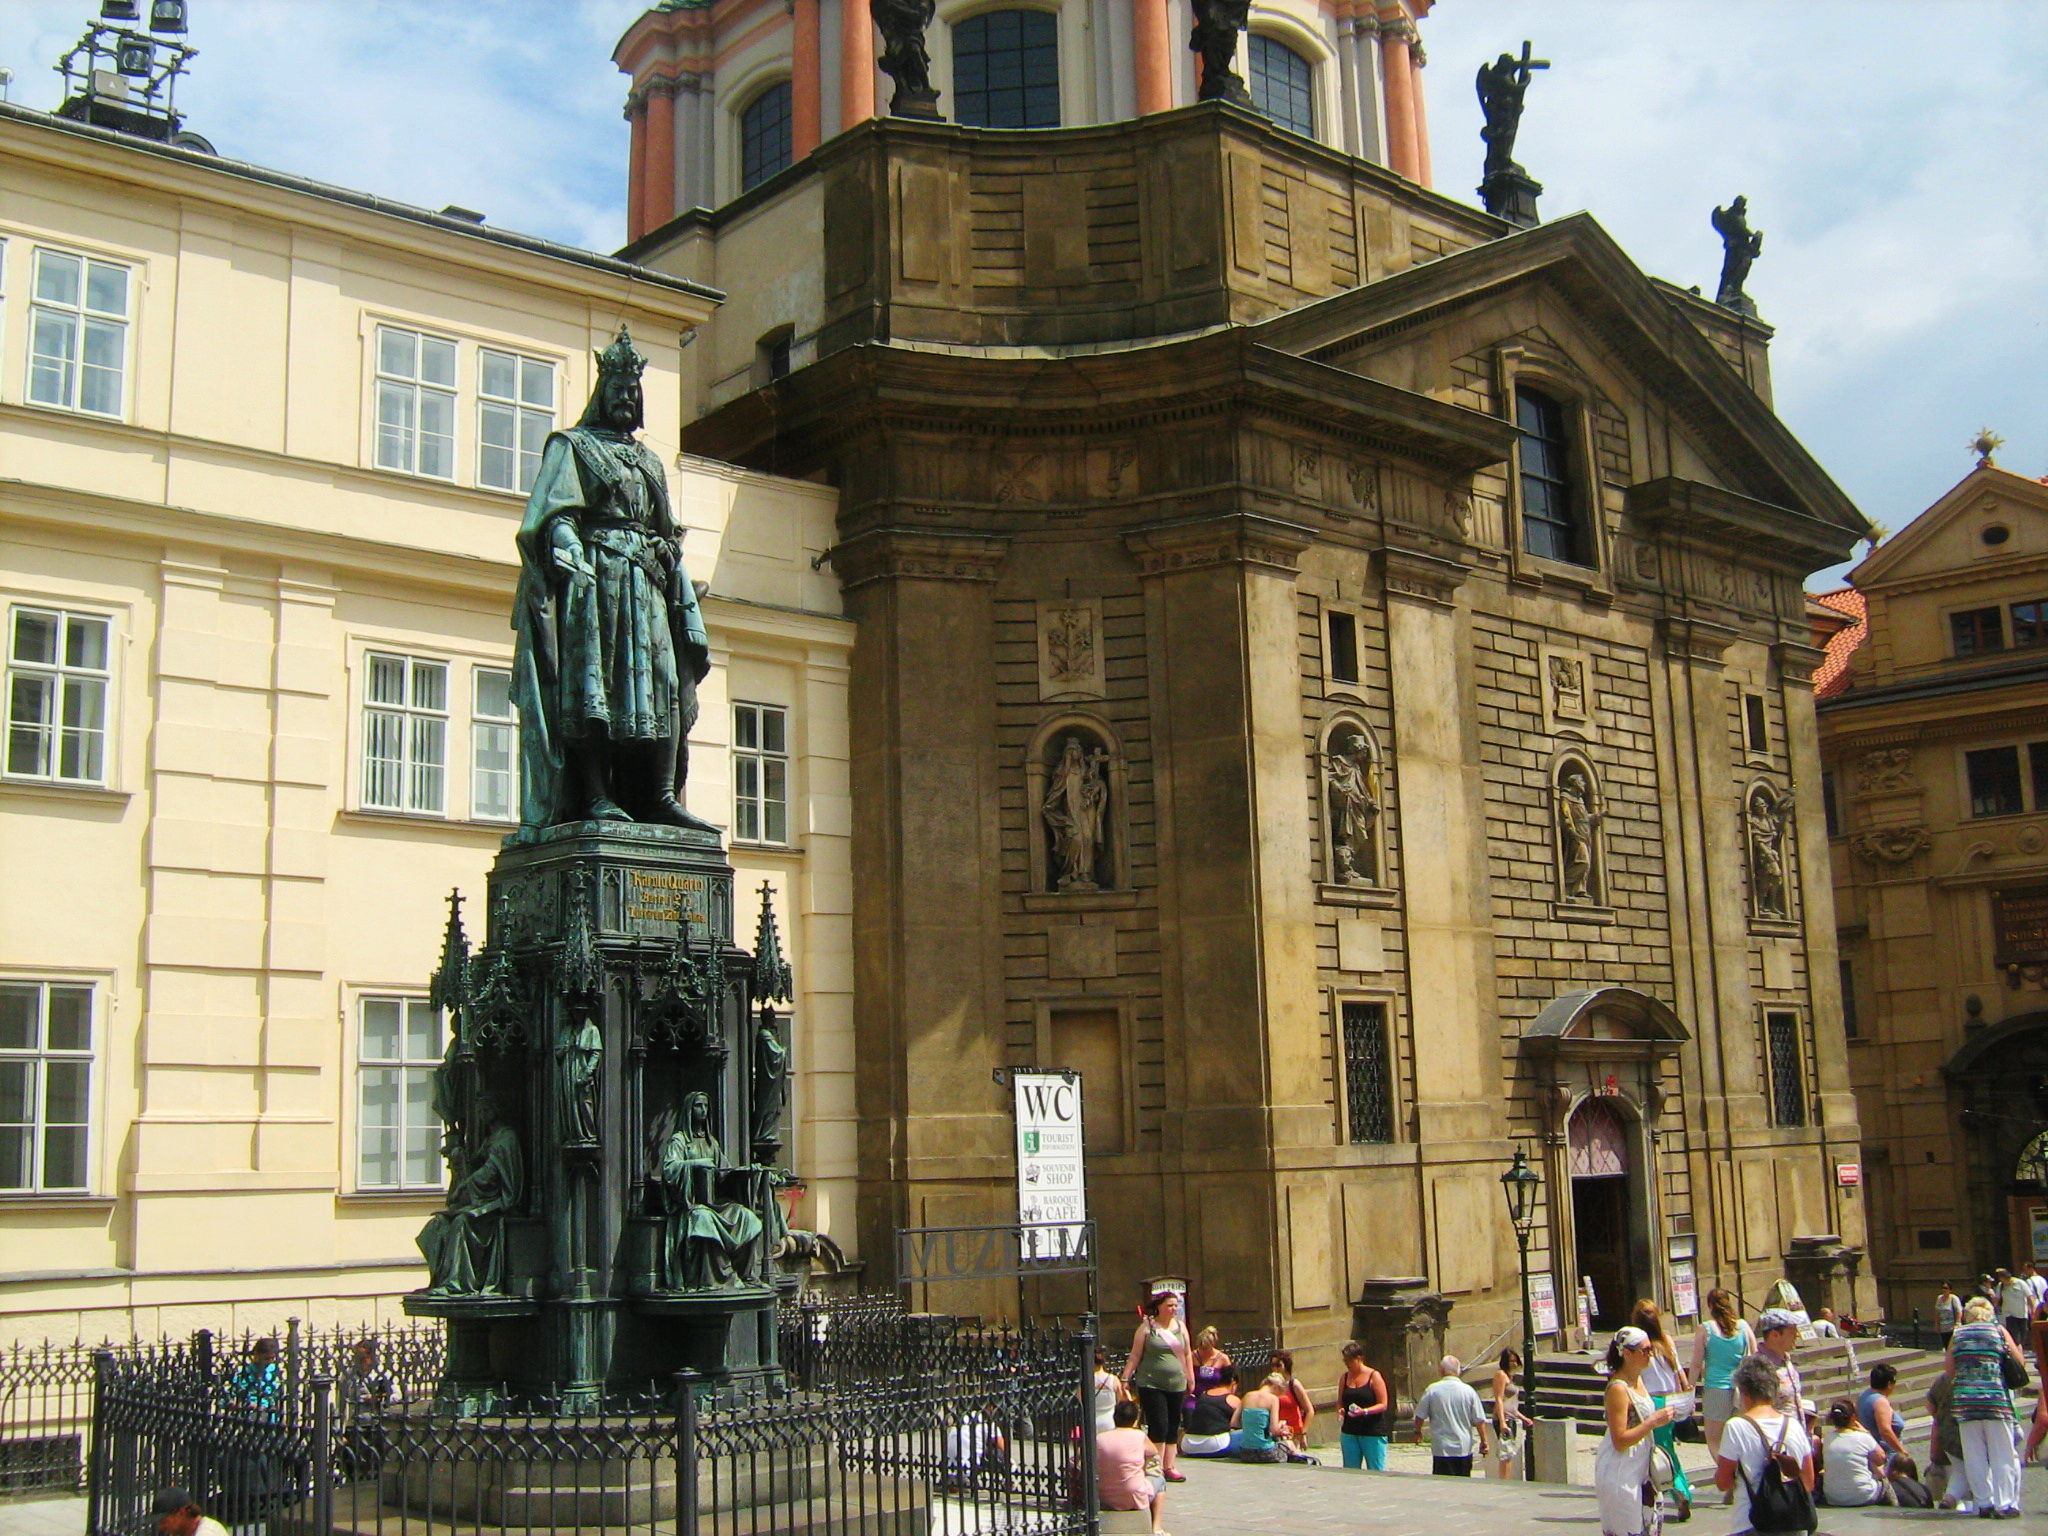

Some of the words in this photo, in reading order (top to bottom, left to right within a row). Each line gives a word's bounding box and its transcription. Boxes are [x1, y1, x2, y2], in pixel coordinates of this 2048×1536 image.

[1022, 1085, 1074, 1122] WC
[1042, 1133, 1075, 1144] TOURIST
[1042, 1164, 1077, 1173] SOUVENIR
[1046, 1173, 1074, 1185] SHOP
[1043, 1195, 1079, 1207] BAROQUE
[902, 1226, 1097, 1276] MUZEUM
